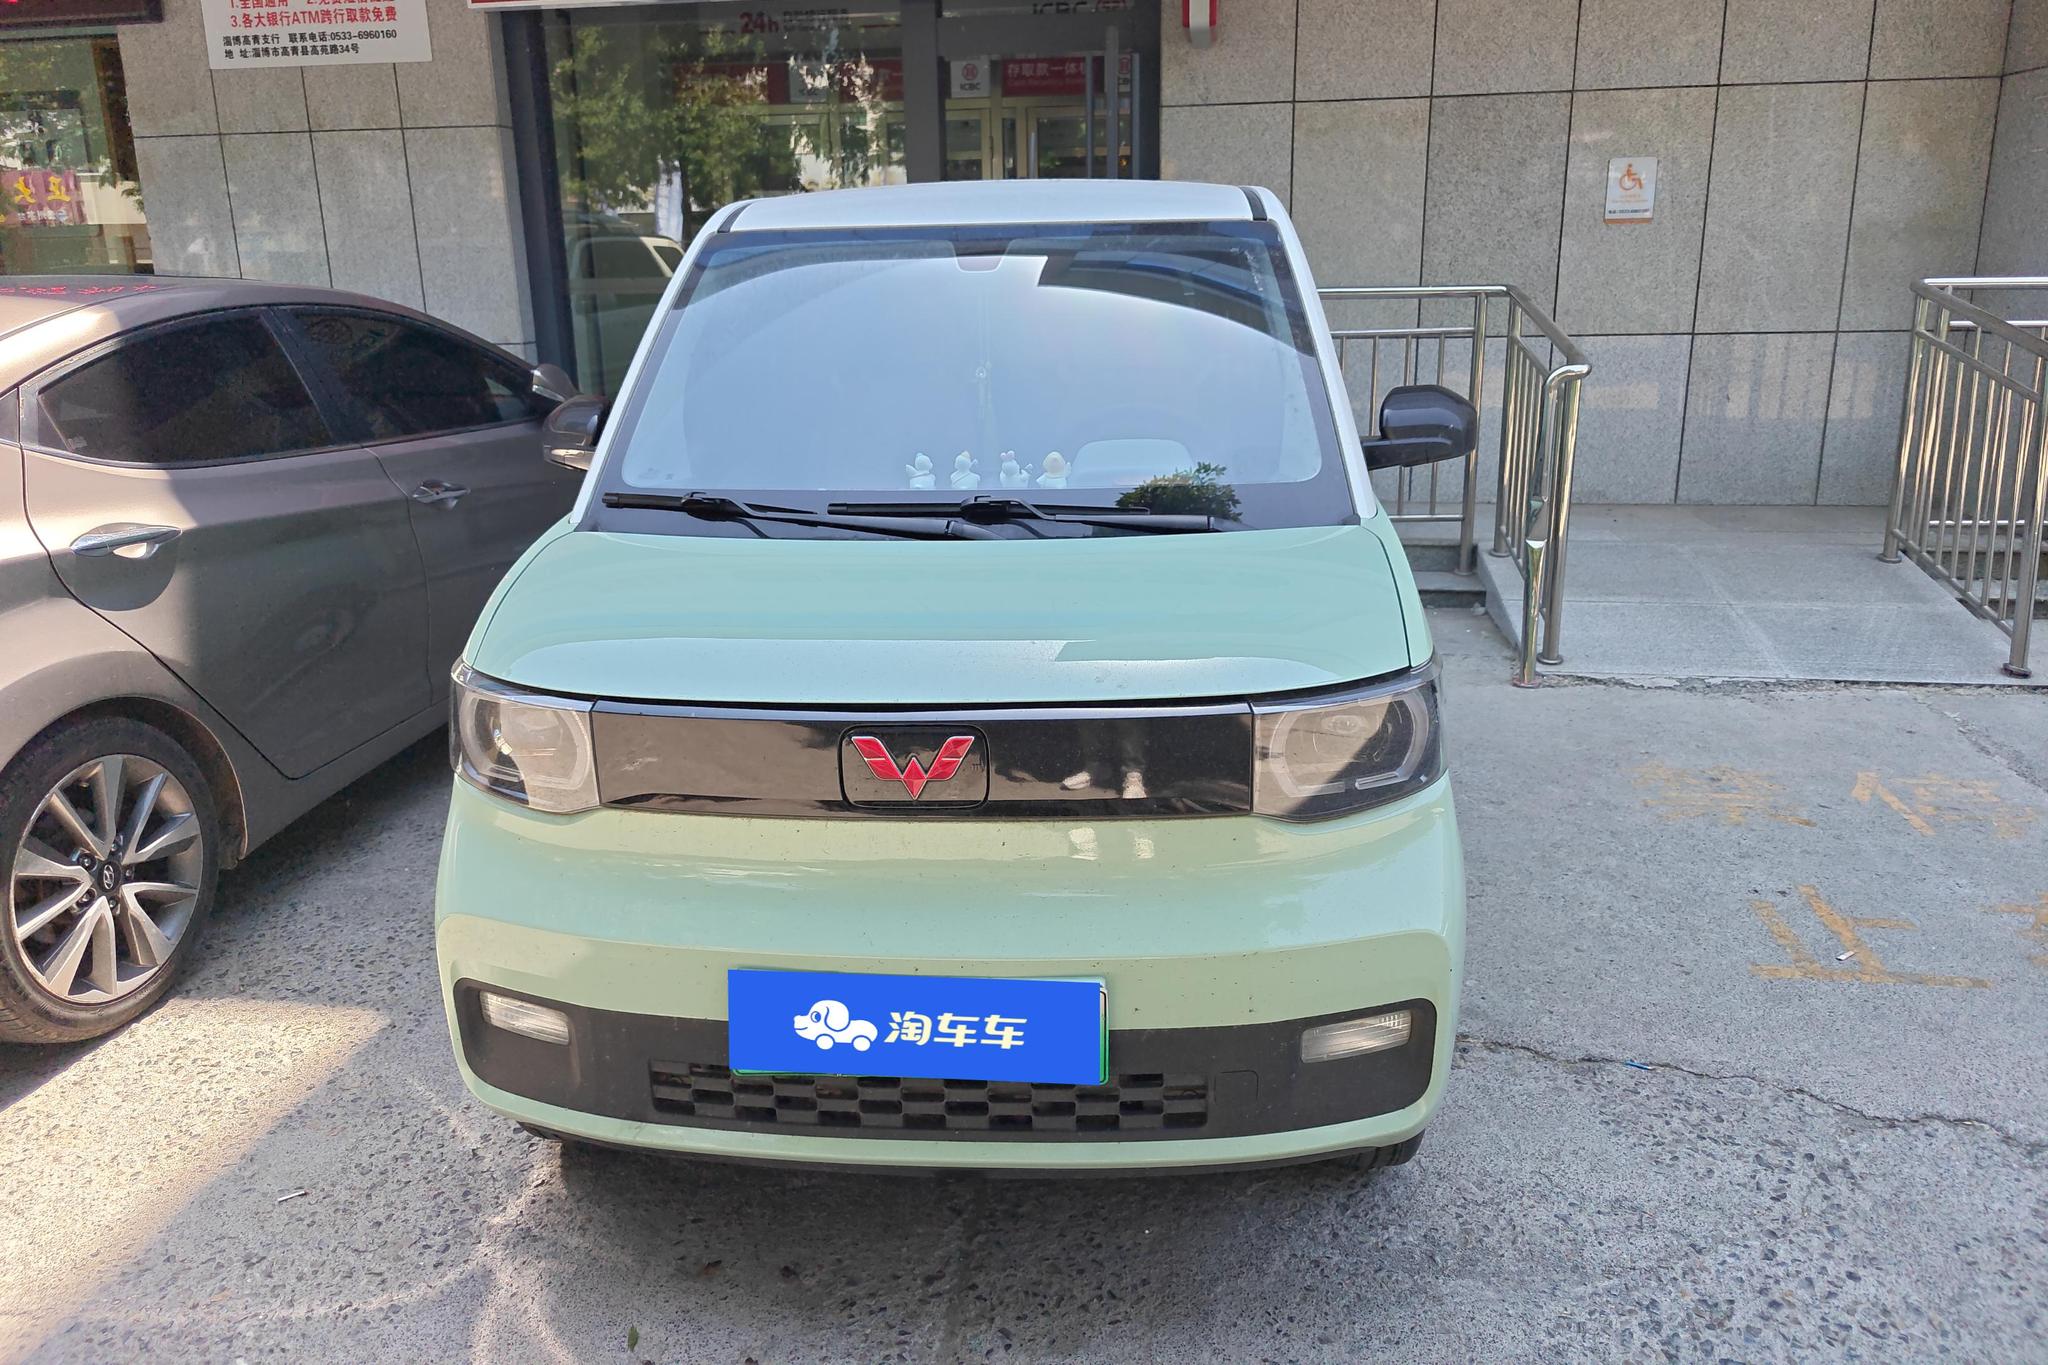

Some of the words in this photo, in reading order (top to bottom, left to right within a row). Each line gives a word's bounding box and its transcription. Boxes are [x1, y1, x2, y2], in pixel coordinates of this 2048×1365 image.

[230, 6, 397, 28] 3.各大银行ATM跨行取款免费
[738, 11, 780, 34] 24h
